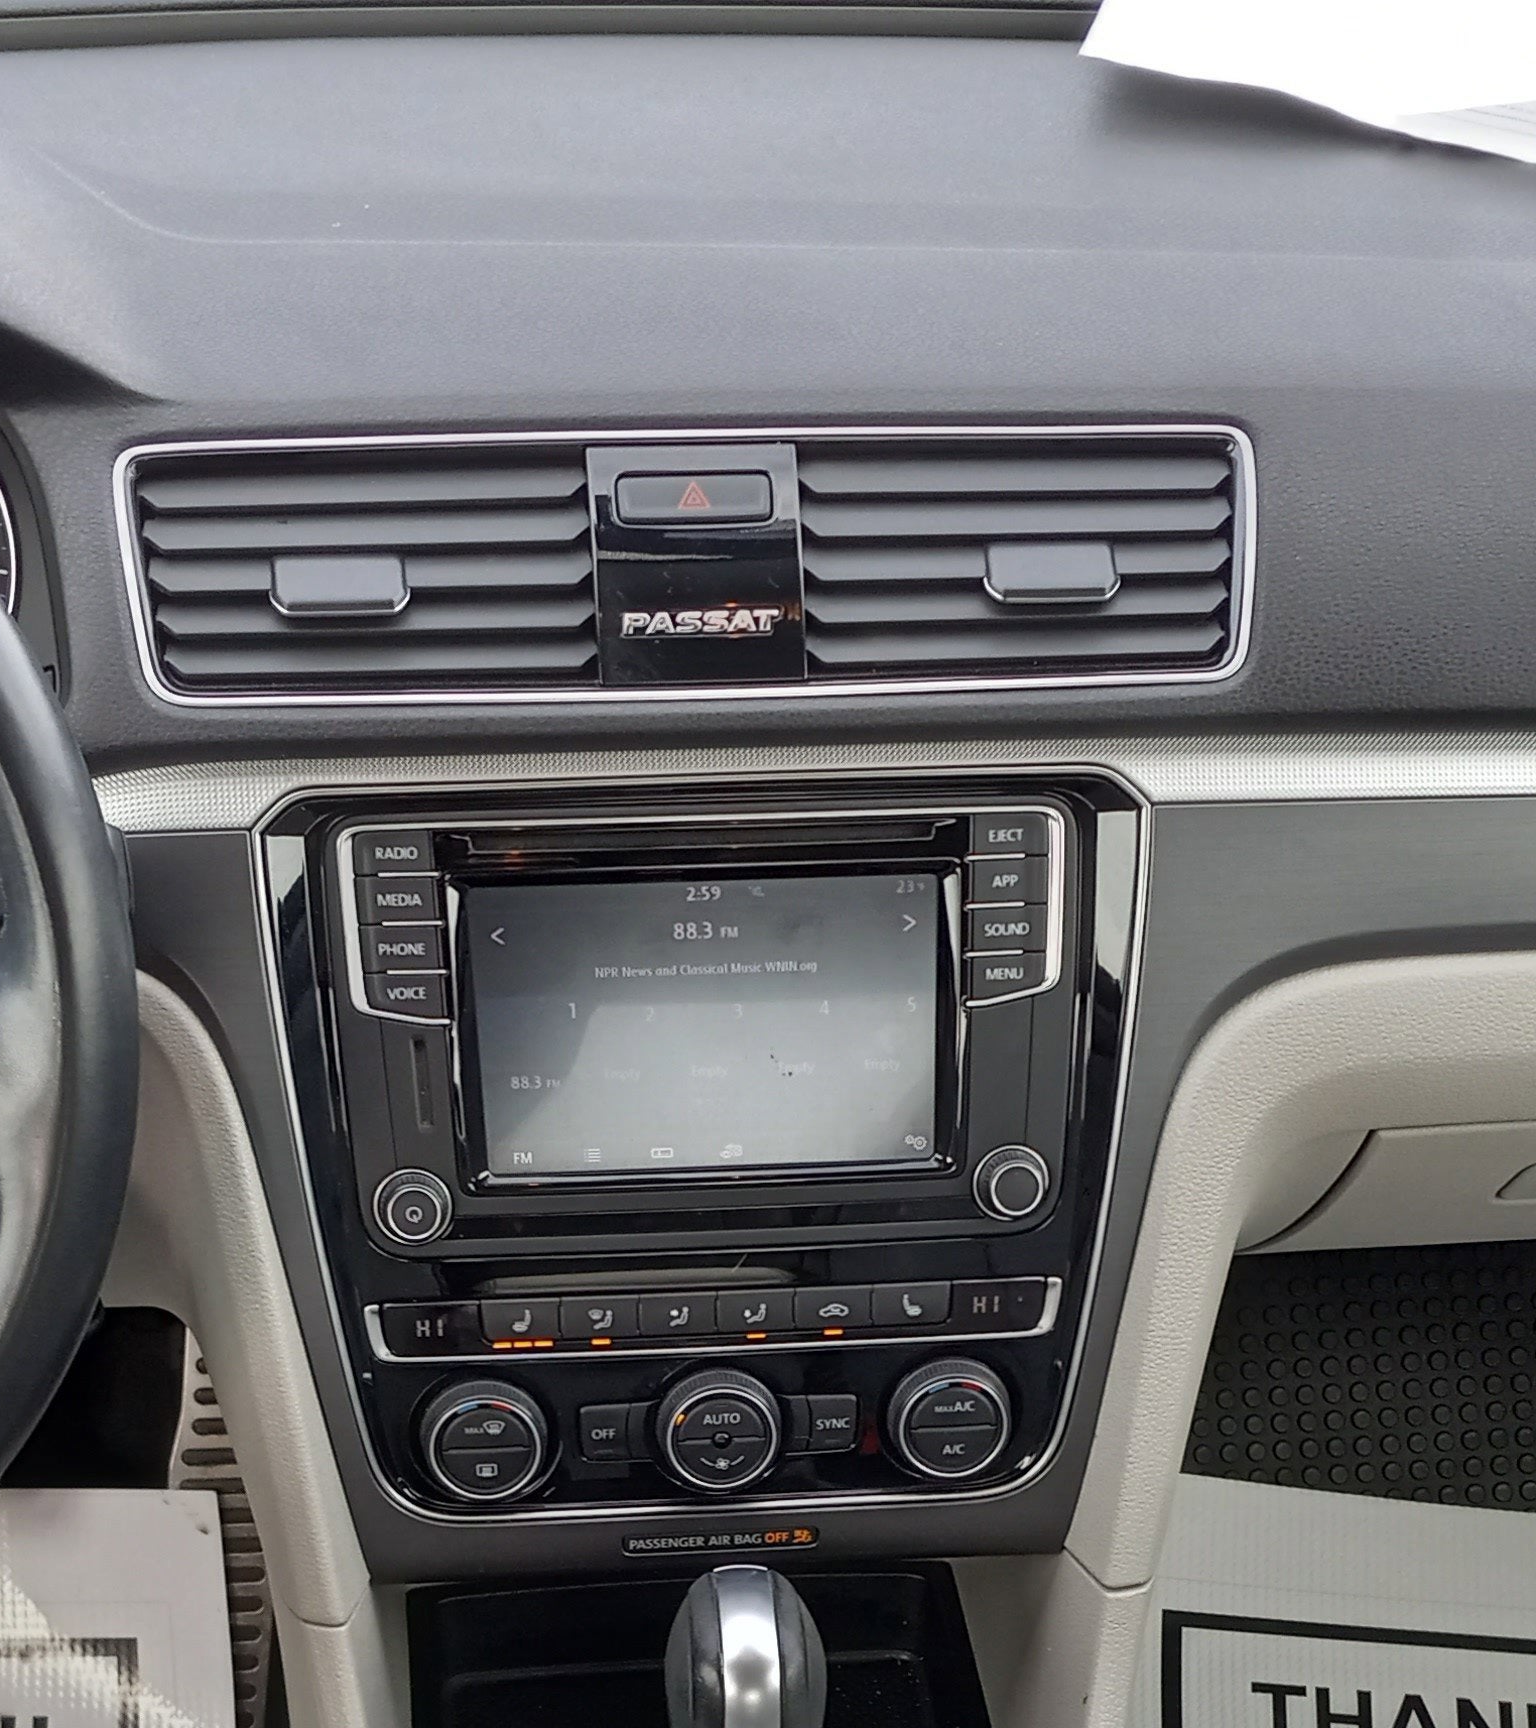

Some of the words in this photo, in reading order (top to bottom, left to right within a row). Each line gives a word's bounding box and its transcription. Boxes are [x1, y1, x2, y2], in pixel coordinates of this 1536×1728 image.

[622, 608, 780, 635] PASSAT
[988, 828, 1024, 842] EJECT
[375, 847, 418, 860] RADIO
[992, 874, 1019, 888] APP
[686, 885, 722, 901] 2:59
[896, 879, 914, 893] 23
[376, 893, 422, 907] MEDIA
[673, 921, 713, 940] 88.3
[720, 925, 739, 939] FM
[984, 922, 1030, 937] SOUND
[377, 943, 426, 956] PHONE
[595, 967, 618, 978] NPR
[622, 966, 652, 977] News
[656, 965, 676, 977] and
[680, 963, 728, 976] Classical
[731, 962, 761, 974] Music
[985, 967, 1024, 980] MENU
[386, 987, 427, 1000] VOICE
[568, 1003, 577, 1019] 1
[819, 1000, 830, 1015] 4
[907, 997, 917, 1012] 5
[510, 1075, 542, 1089] 88.3
[514, 1152, 533, 1164] FM
[703, 1412, 741, 1425] AUTO
[816, 1417, 850, 1430] SYNC
[591, 1428, 616, 1440] OFF
[942, 1444, 965, 1455] A/C
[628, 1536, 704, 1550] PASSENGER
[708, 1535, 731, 1546] AIR
[734, 1534, 762, 1545] BAG
[764, 1532, 789, 1543] OFF
